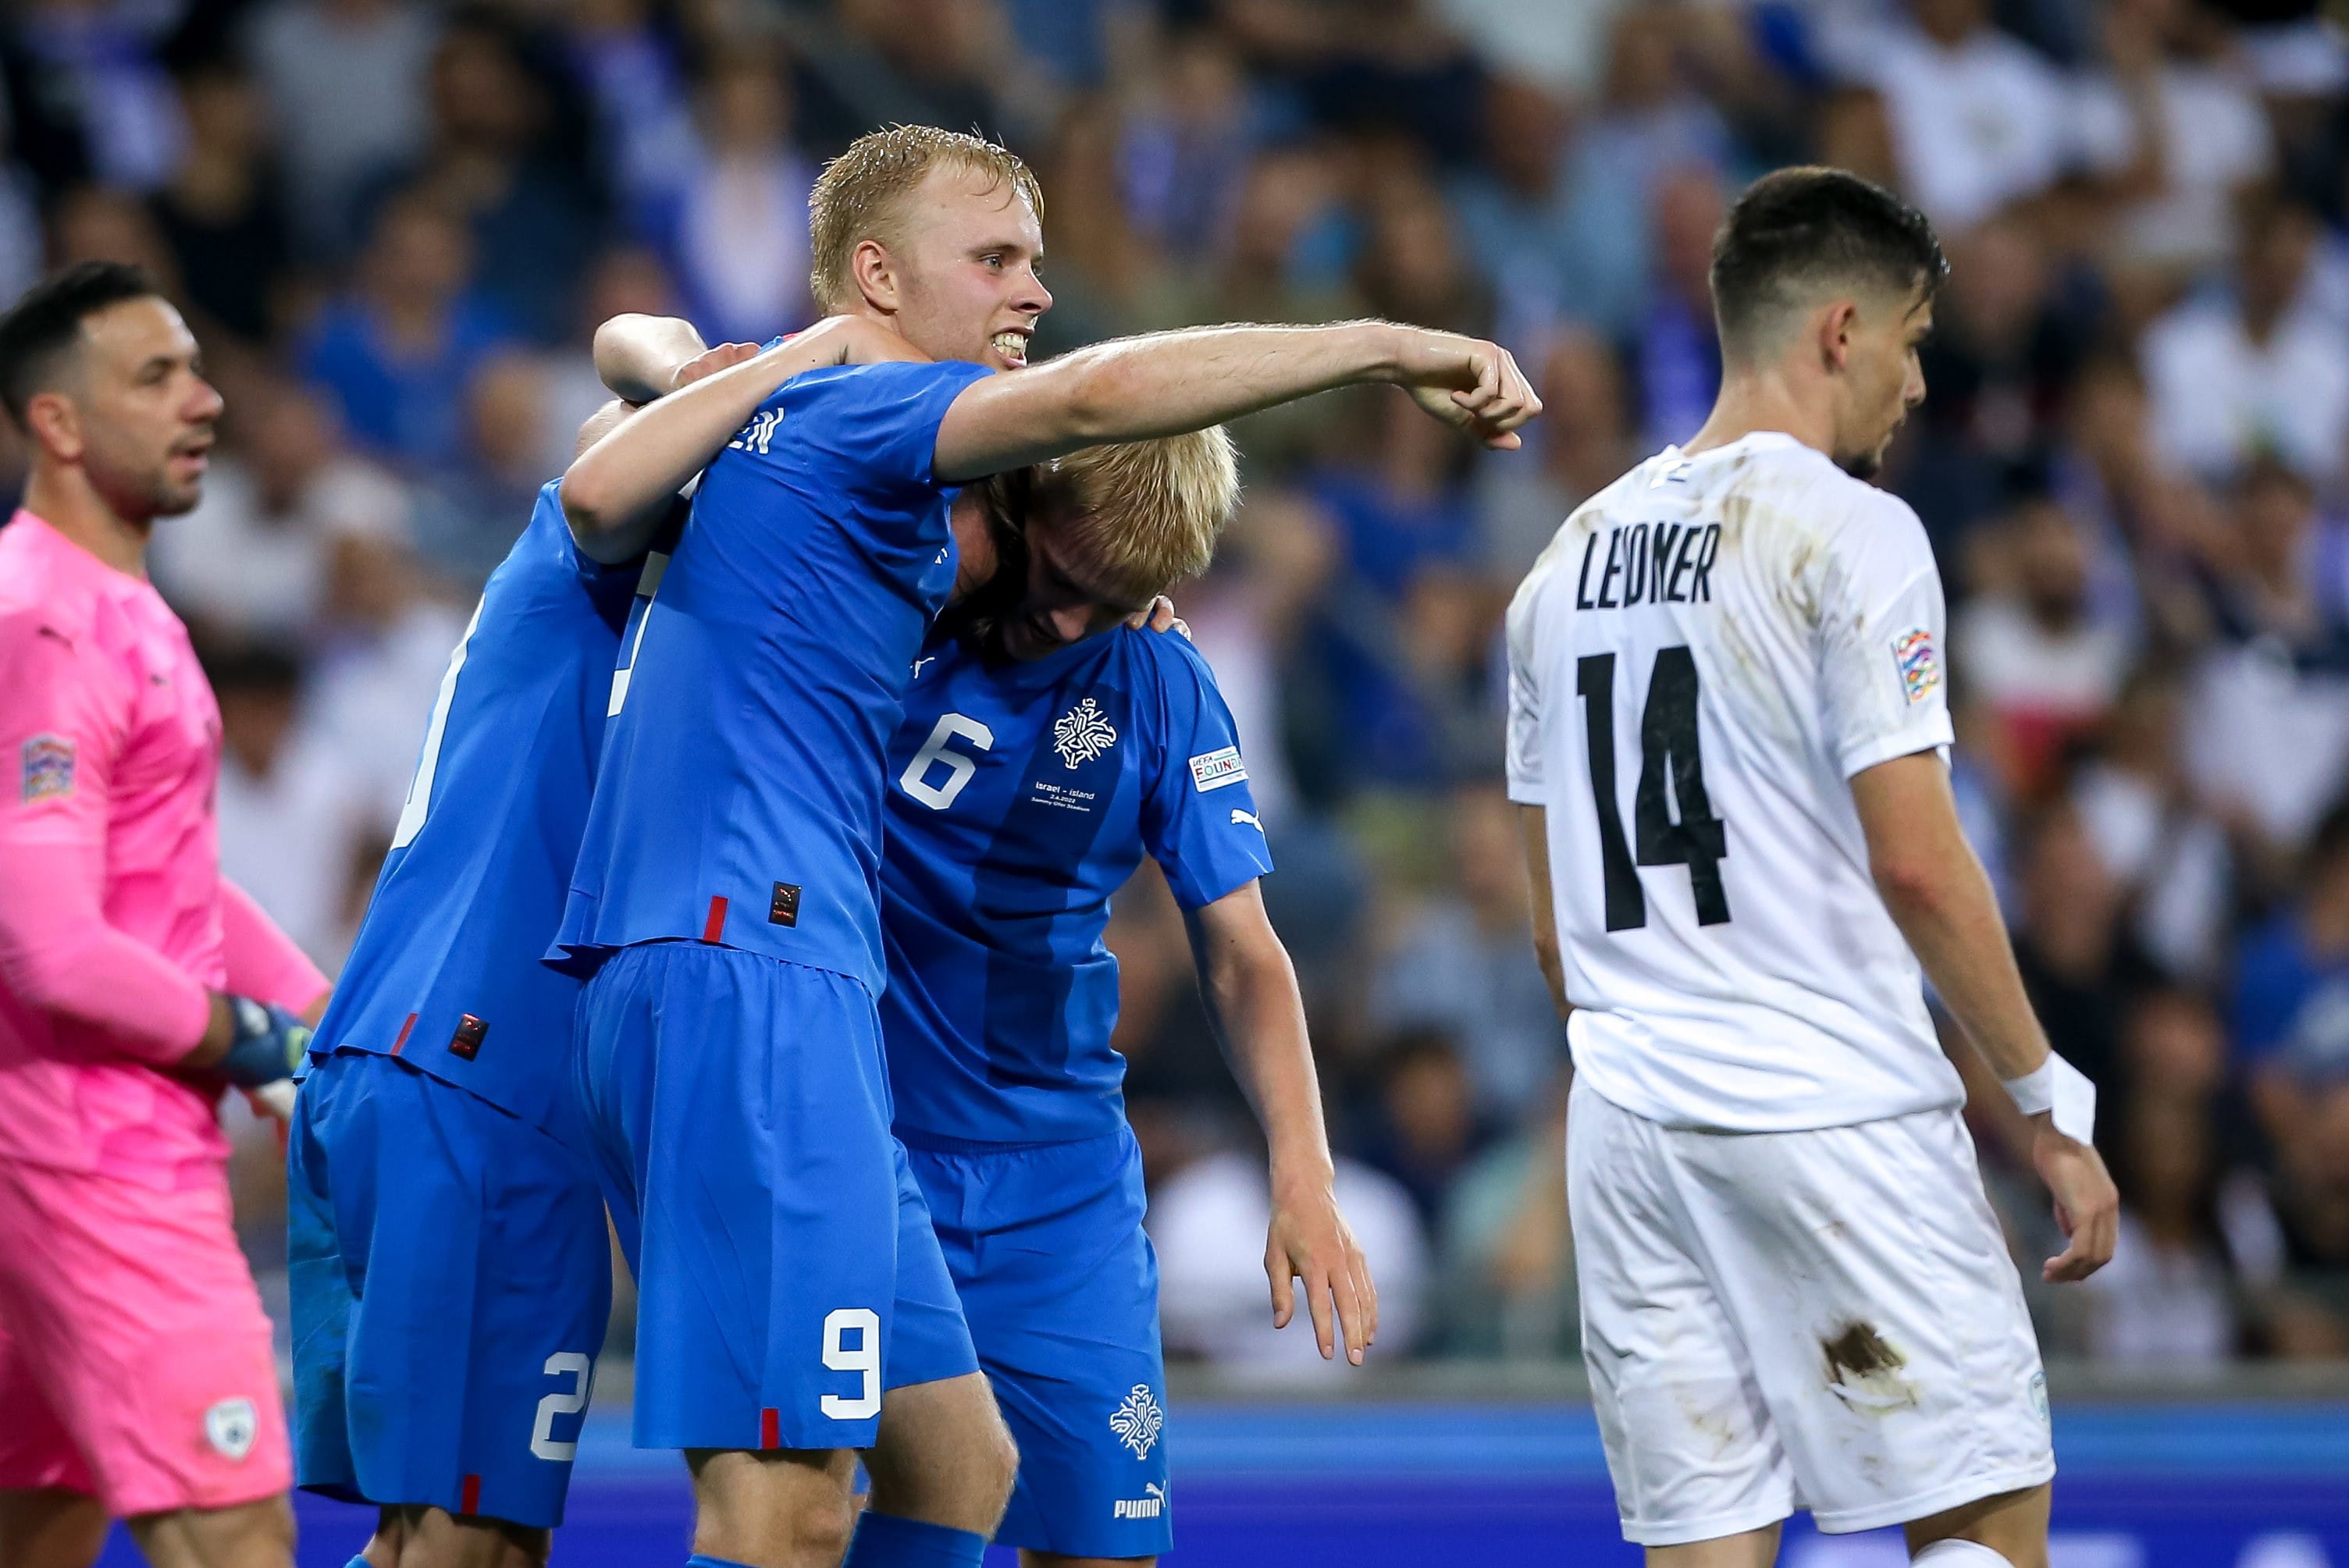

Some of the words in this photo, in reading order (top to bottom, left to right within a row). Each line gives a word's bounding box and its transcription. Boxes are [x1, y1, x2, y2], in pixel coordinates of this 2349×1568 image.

[899, 712, 995, 810] 6
[1035, 780, 1061, 794] Israel
[1192, 755, 1213, 767] UEFA
[1576, 645, 1731, 933] 14
[820, 1307, 882, 1420] 9
[1114, 1498, 1161, 1519] PUMA
